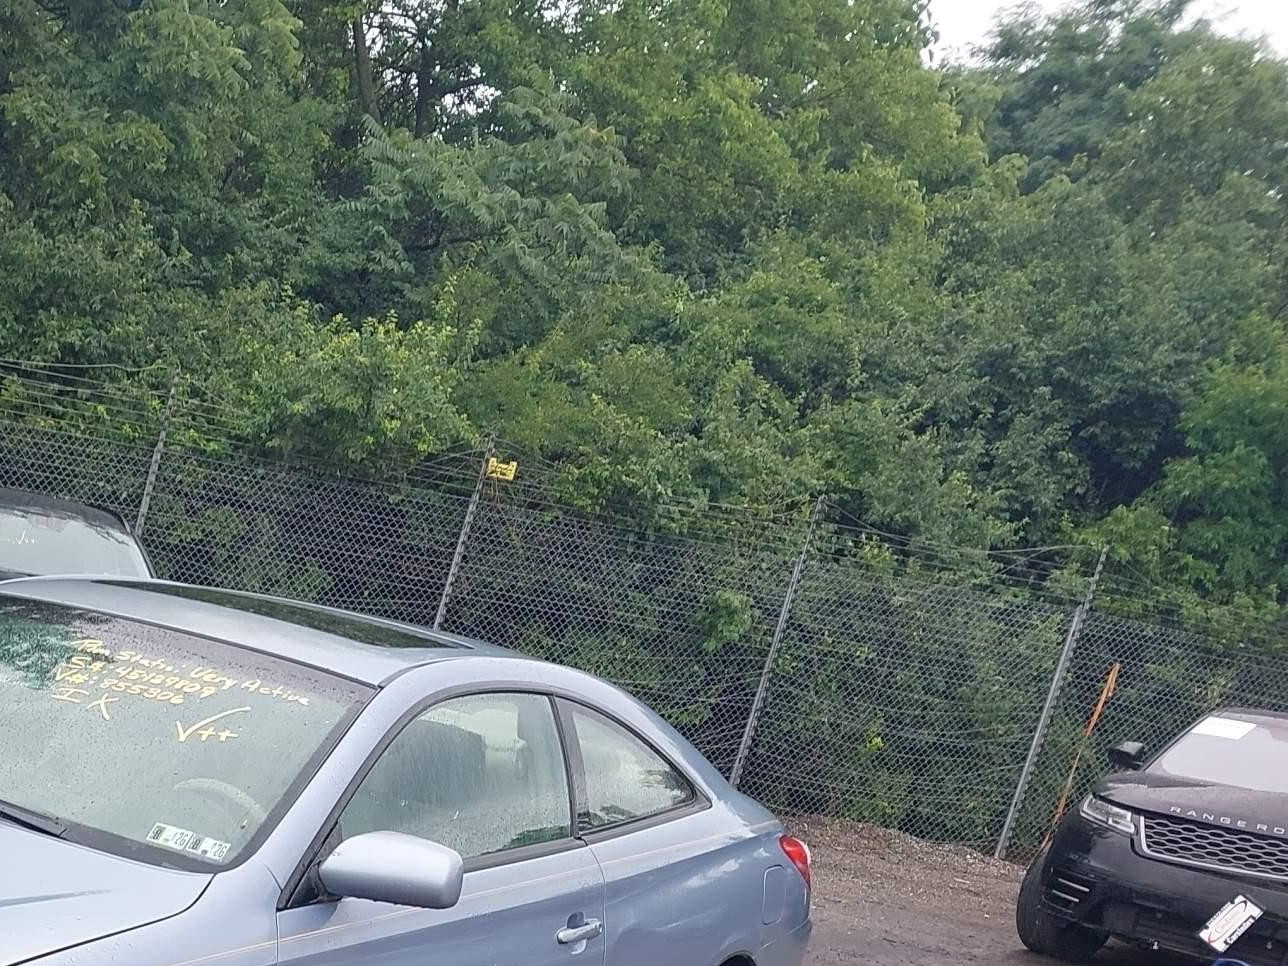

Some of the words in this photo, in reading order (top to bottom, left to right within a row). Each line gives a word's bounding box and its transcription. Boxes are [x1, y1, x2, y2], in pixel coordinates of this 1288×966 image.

[190, 667, 239, 690] Very
[240, 679, 310, 706] Active
[1170, 806, 1247, 828] RANGE
[1256, 823, 1286, 835] RO
